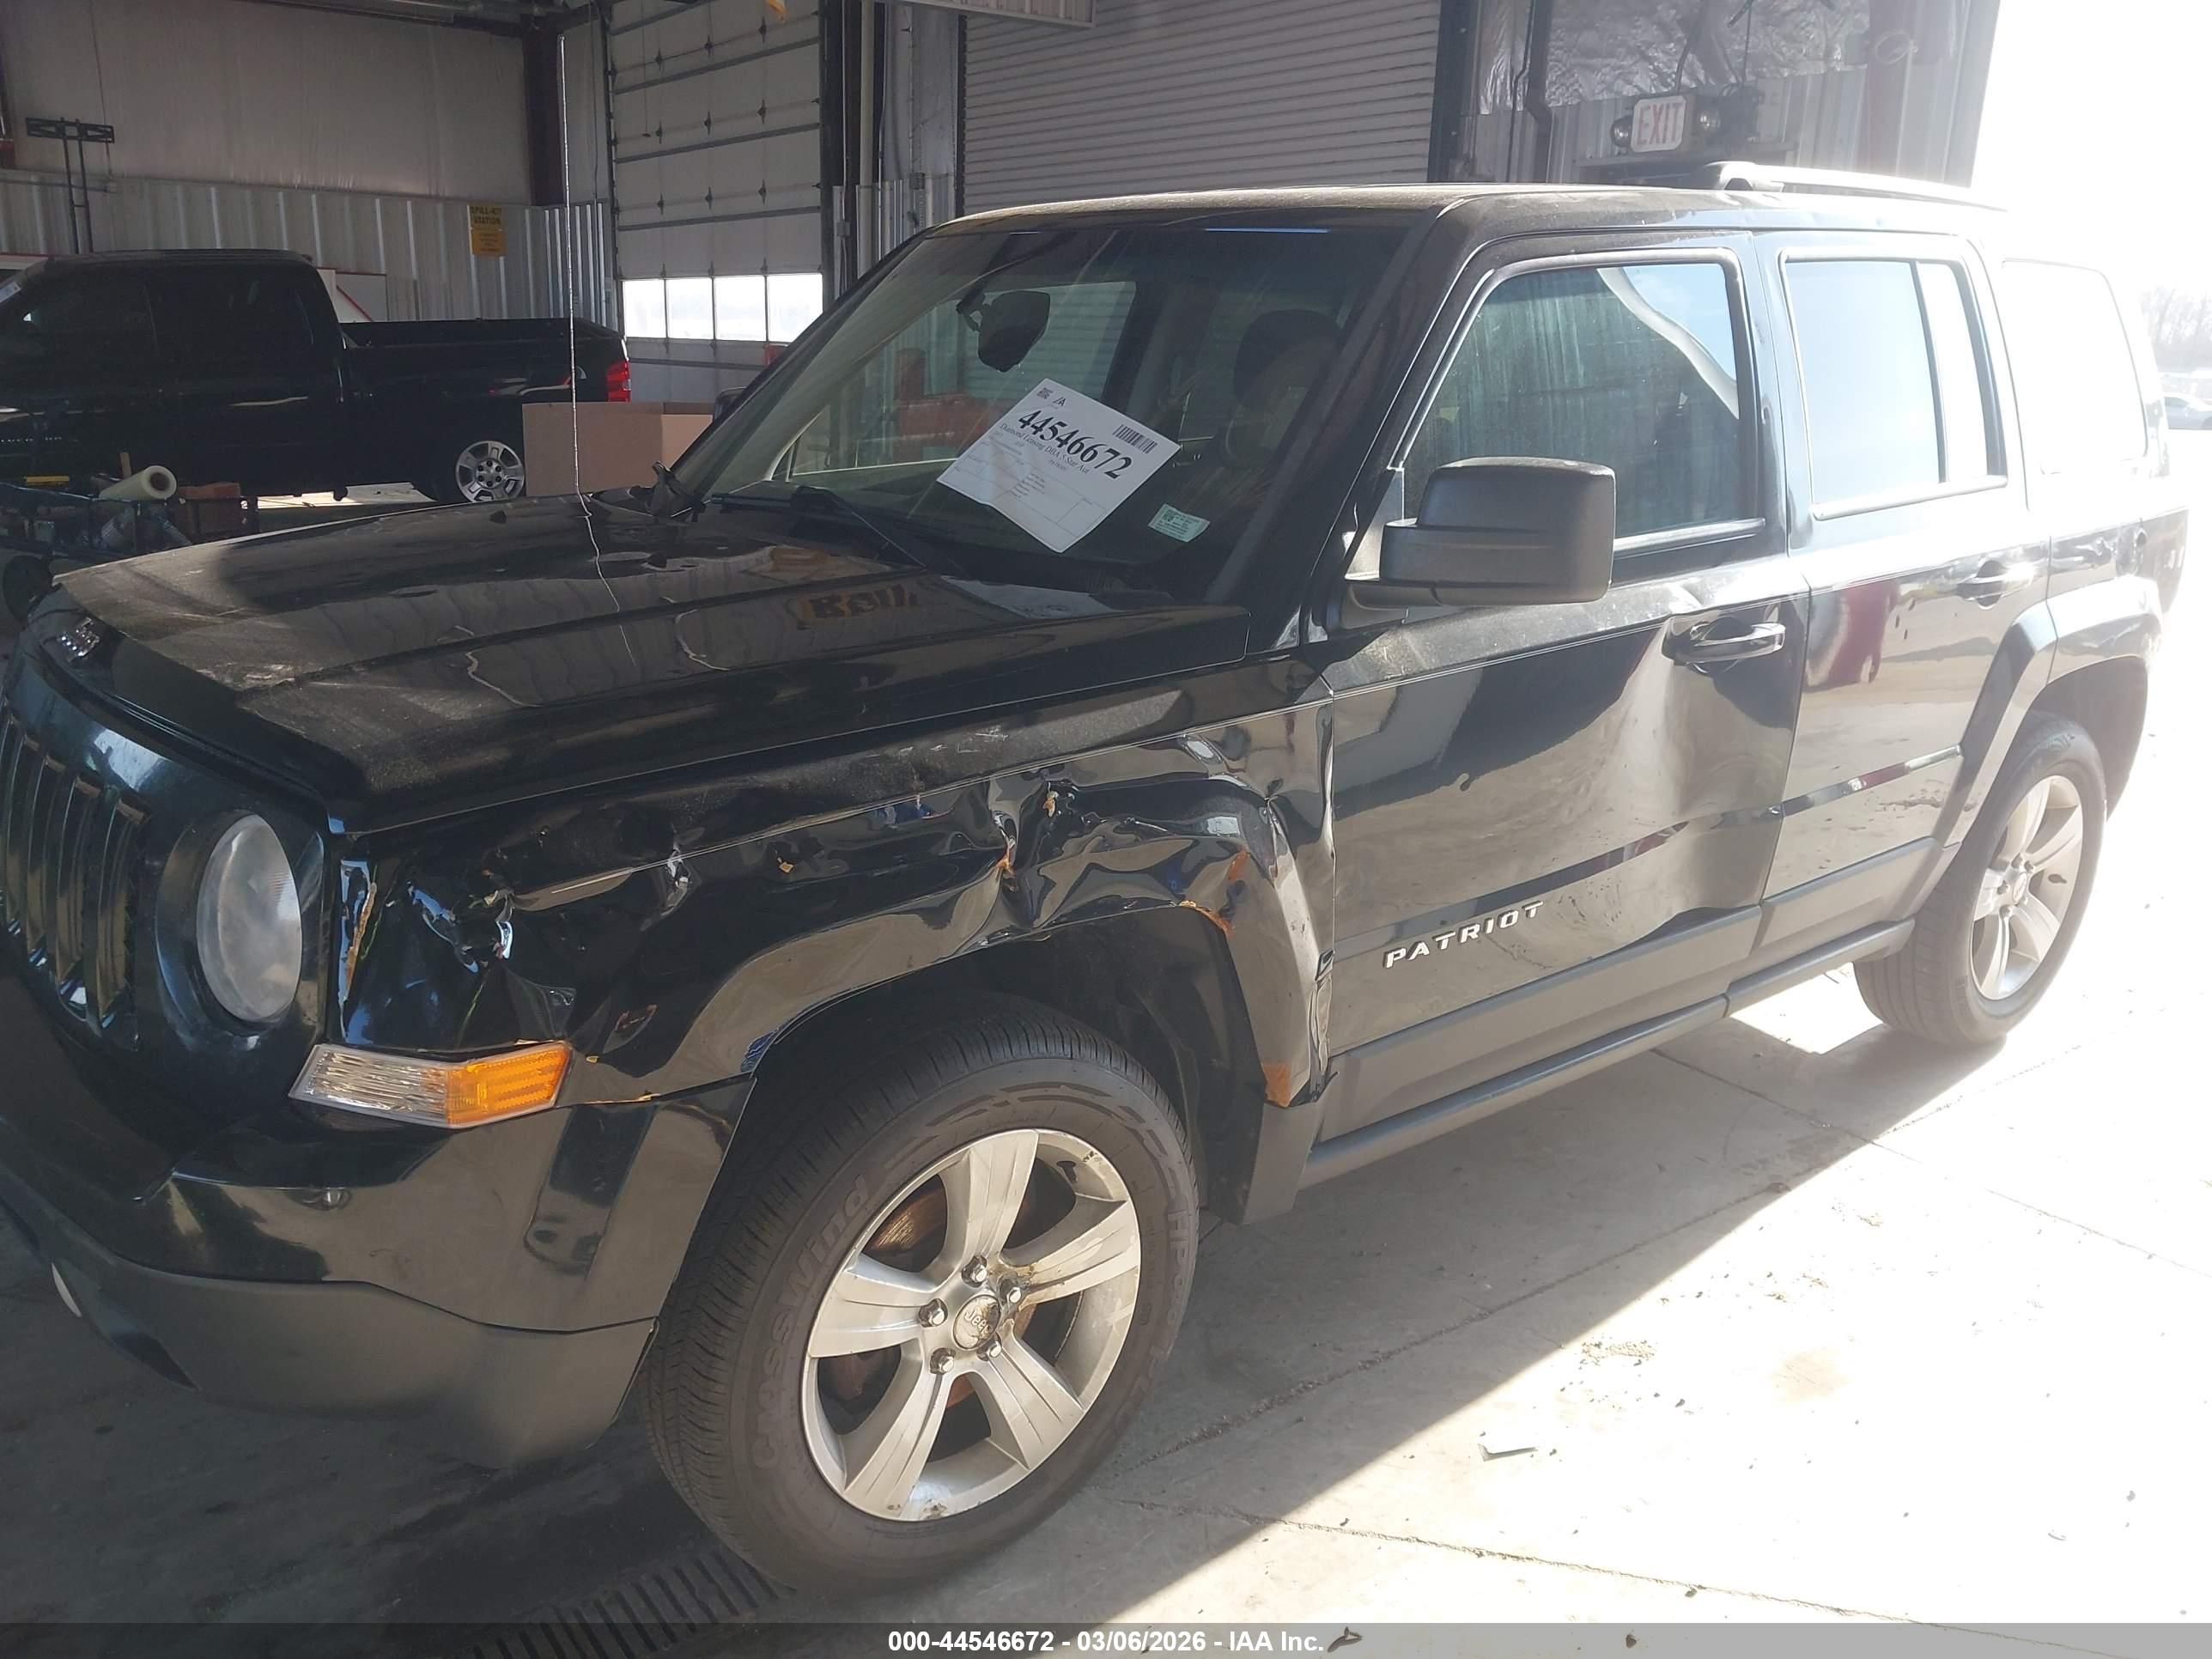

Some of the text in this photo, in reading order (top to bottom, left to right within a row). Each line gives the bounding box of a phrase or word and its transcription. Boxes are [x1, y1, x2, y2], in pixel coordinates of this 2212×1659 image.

[1637, 102, 1682, 144] EXIT
[1018, 410, 1133, 479] 44546672
[1383, 901, 1544, 969] PATRIOT
